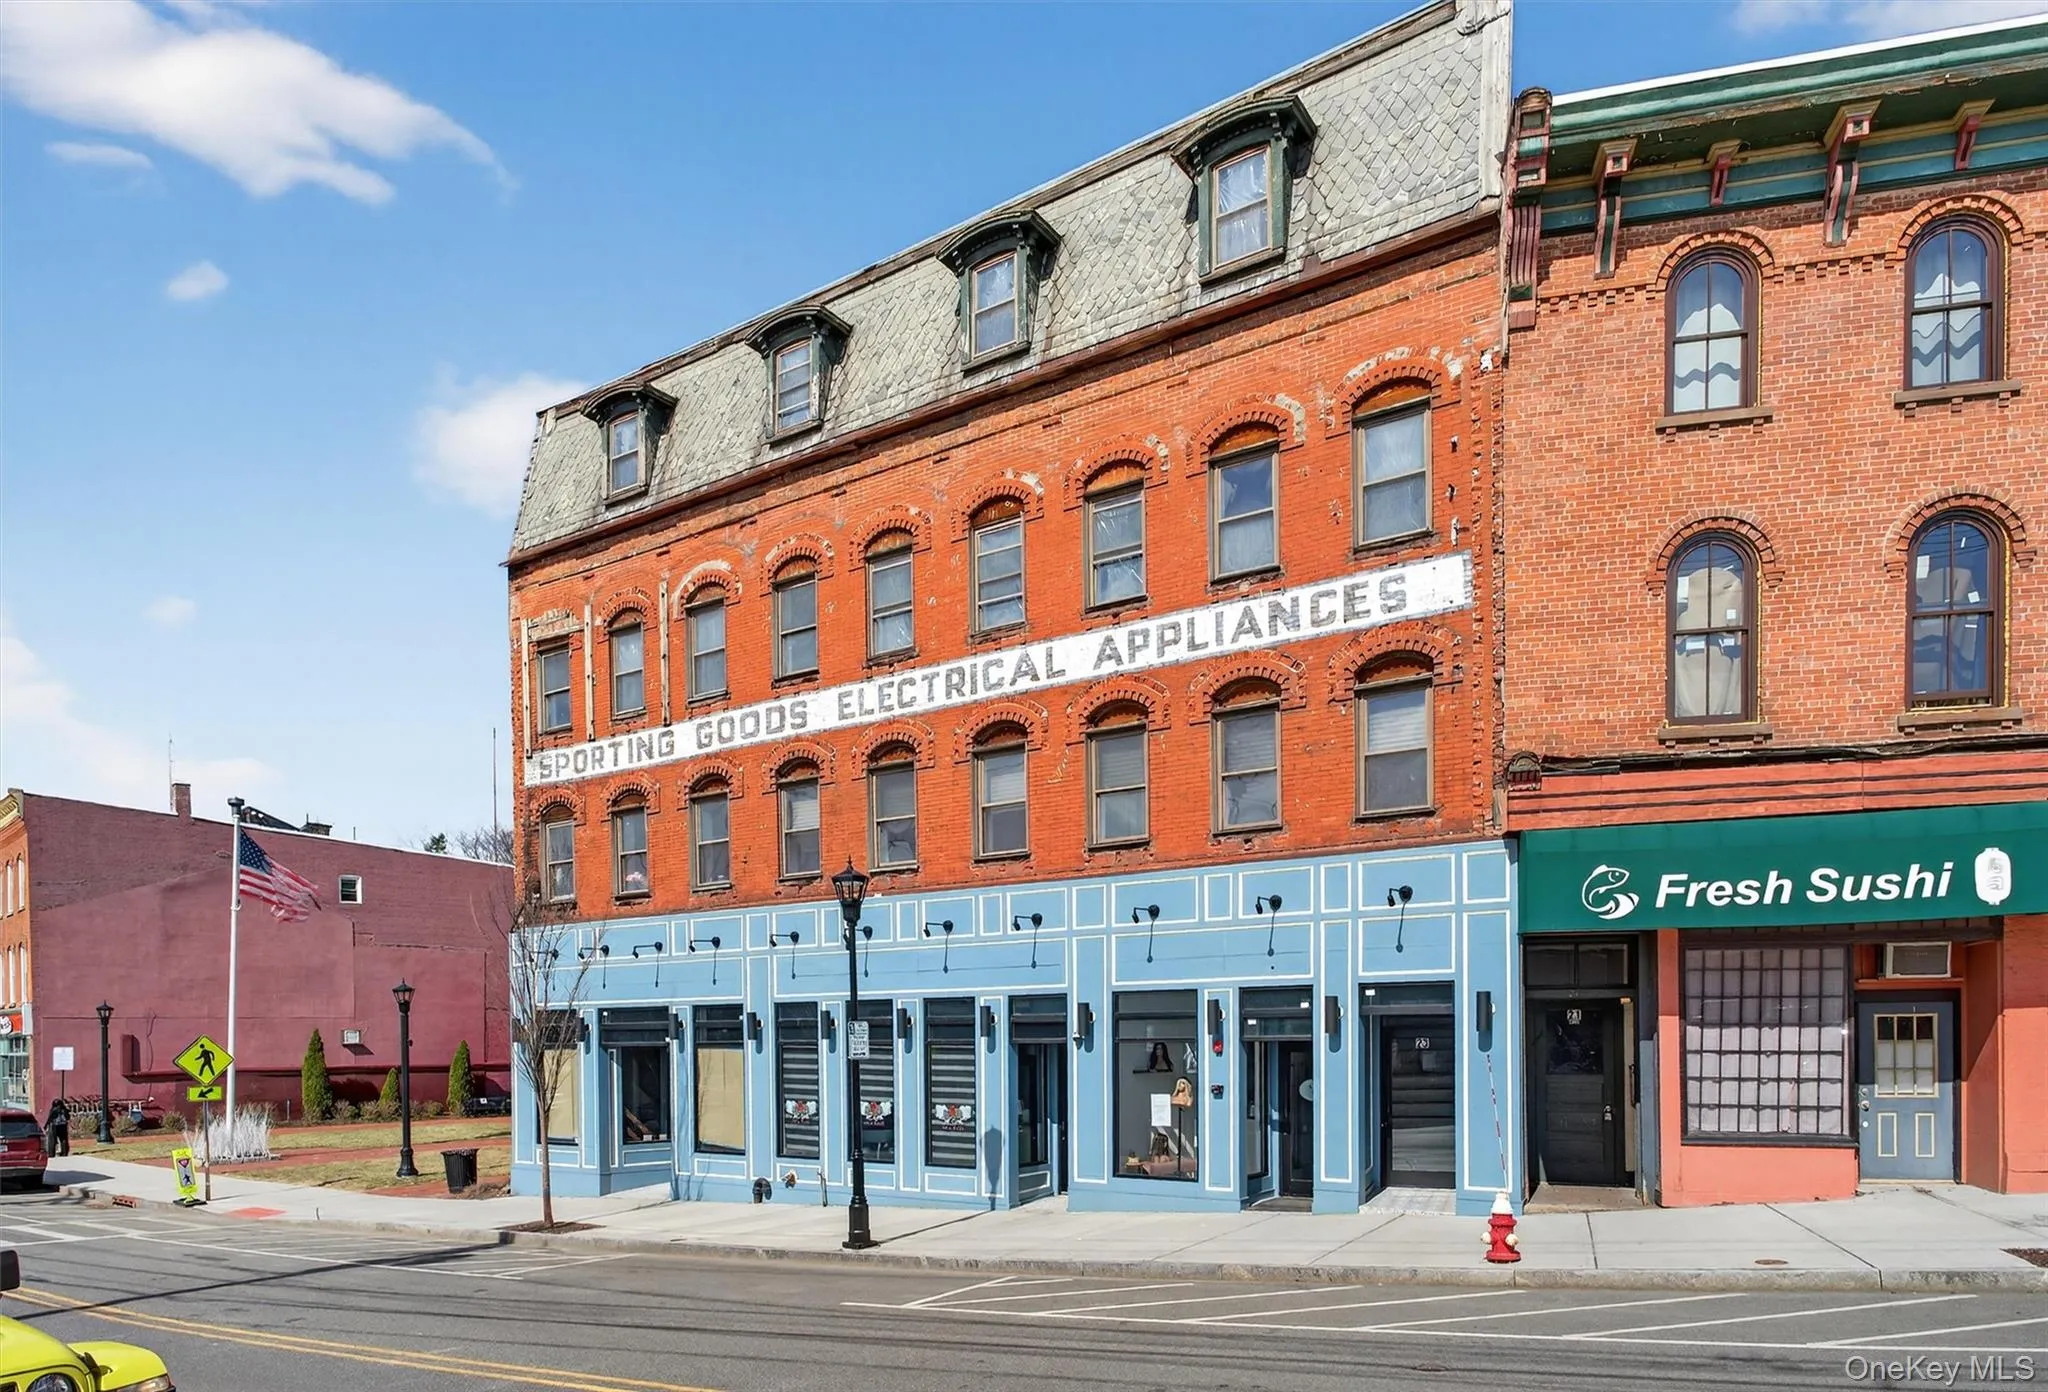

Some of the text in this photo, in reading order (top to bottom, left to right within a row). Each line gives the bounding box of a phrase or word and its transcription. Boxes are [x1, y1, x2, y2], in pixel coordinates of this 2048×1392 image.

[539, 573, 1406, 779] SPORTING GOODS ELECTRICAL APPLIANCES
[1655, 862, 1953, 908] Fresh Sushi
